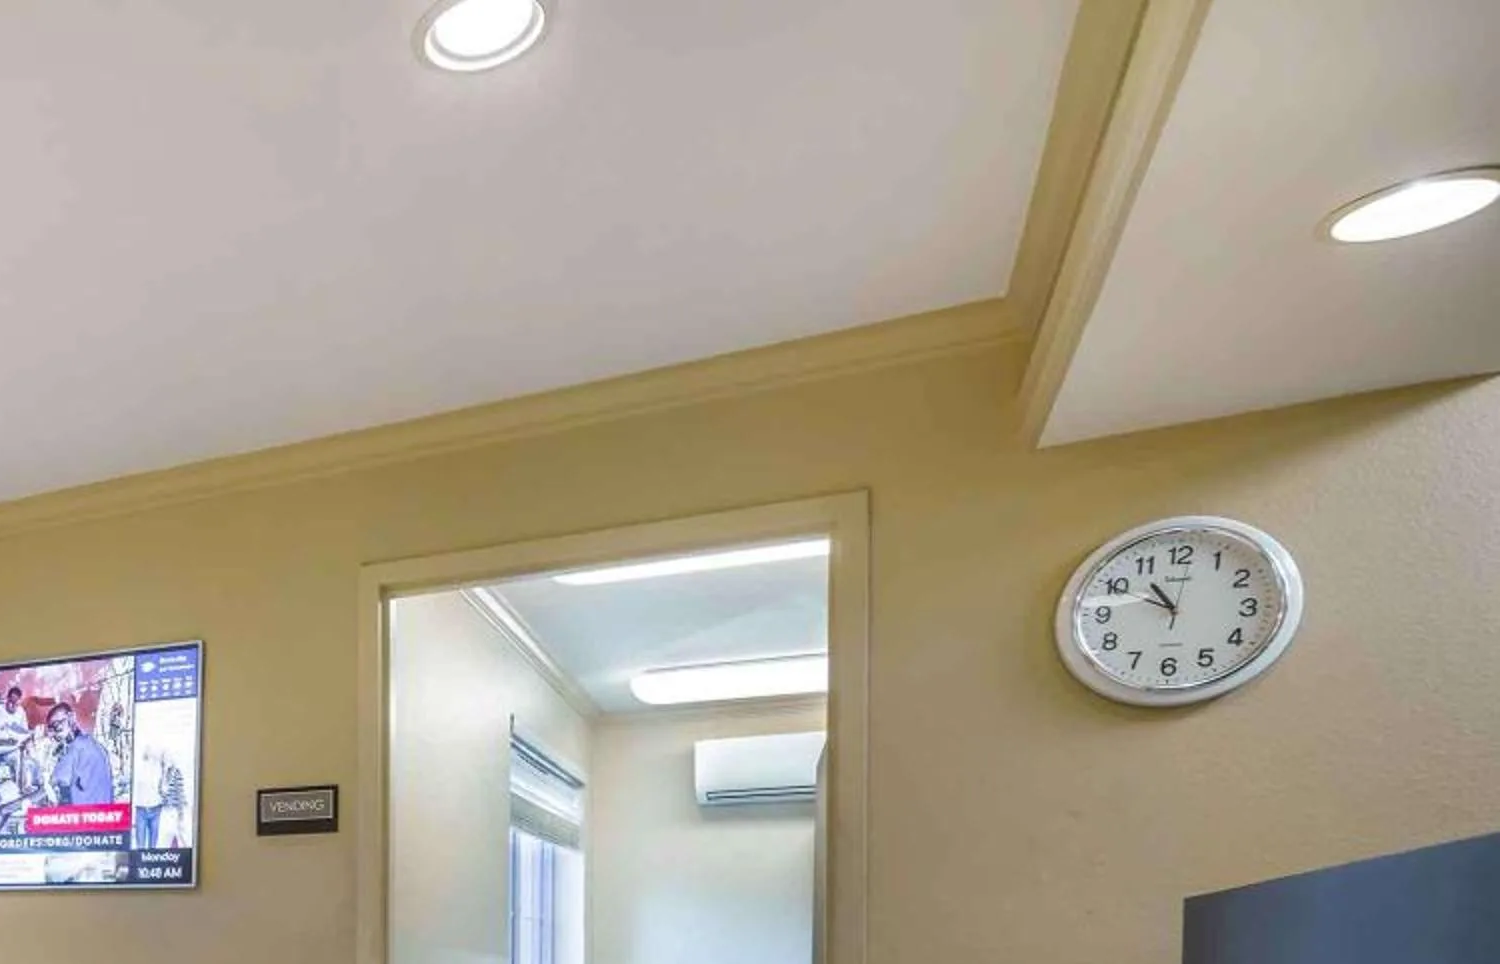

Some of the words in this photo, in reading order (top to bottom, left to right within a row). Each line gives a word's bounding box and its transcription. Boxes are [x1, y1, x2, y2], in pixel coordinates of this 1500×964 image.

[1168, 545, 1193, 565] 12
[1213, 551, 1222, 571] 1
[1135, 556, 1154, 575] 11
[1106, 577, 1129, 595] 10
[1233, 569, 1250, 588] 2
[1094, 606, 1111, 624] 9
[1239, 598, 1257, 617] 3
[1102, 632, 1118, 650] 8
[1227, 628, 1244, 645] 4
[1128, 651, 1142, 669] 7
[1160, 657, 1177, 676] 6
[1196, 649, 1213, 667] 5
[269, 799, 325, 813] VENDING
[33, 812, 81, 825] DONATE
[83, 811, 123, 823] TODAY
[141, 851, 181, 863] Monday
[163, 866, 184, 879] AM
